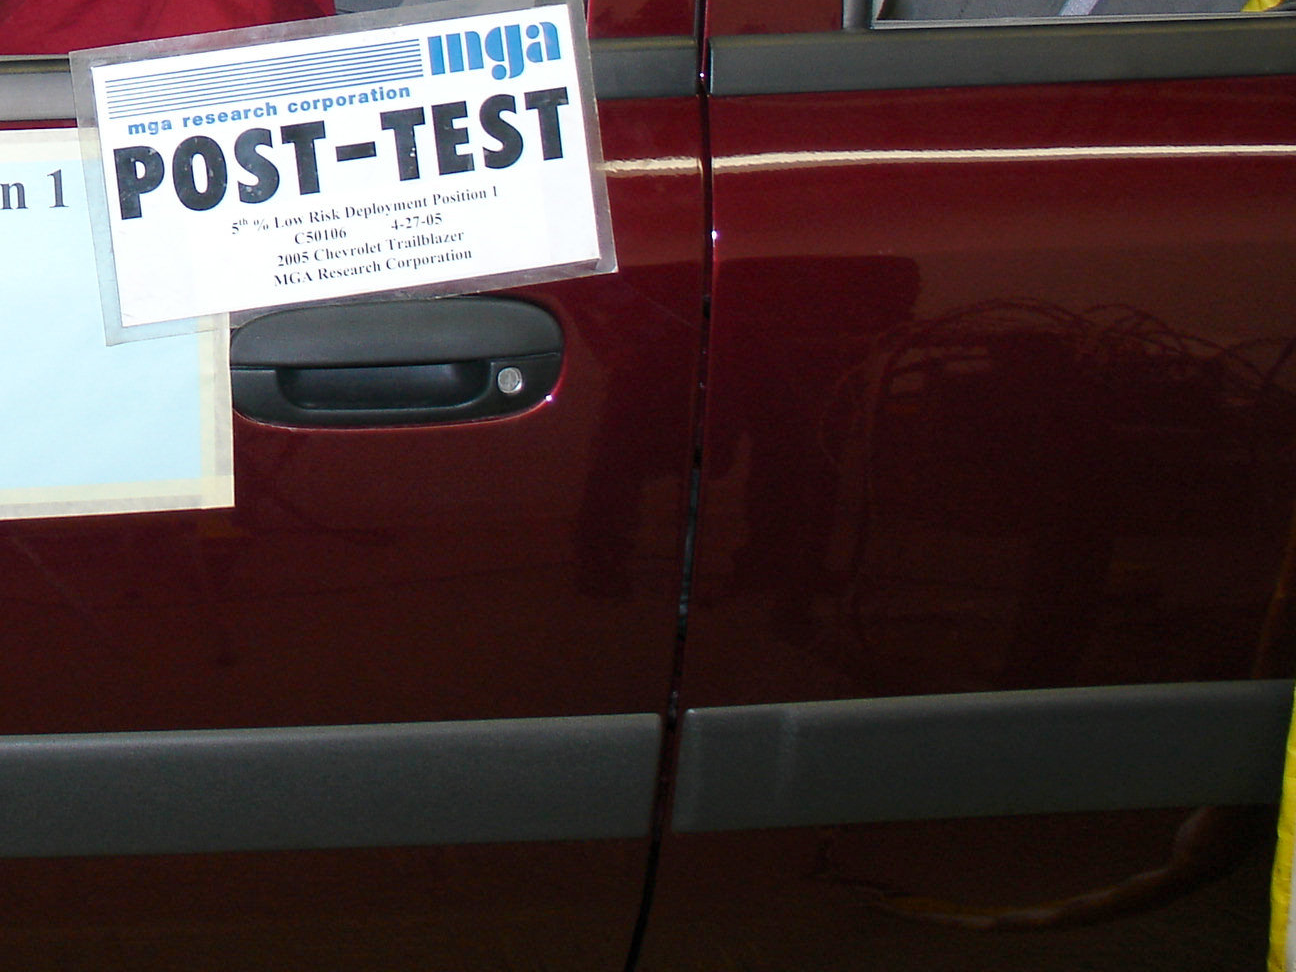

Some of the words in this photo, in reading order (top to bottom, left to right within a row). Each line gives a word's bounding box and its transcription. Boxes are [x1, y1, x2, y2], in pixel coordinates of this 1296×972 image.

[428, 21, 562, 80] mga
[128, 118, 172, 136] mga
[183, 102, 279, 127] research
[287, 85, 411, 115] corporation
[113, 87, 570, 221] POST-TEST
[49, 169, 68, 209] 1
[274, 212, 304, 229] Low
[309, 208, 341, 223] Risk
[345, 196, 428, 221] Deployment
[432, 187, 488, 207] Position
[277, 251, 310, 267] 2005
[313, 241, 382, 263] Chevrolet
[385, 230, 464, 251] Trailblazer
[294, 227, 347, 245] C50106
[391, 212, 443, 231] 4-27-05
[274, 270, 314, 287] MGA
[318, 261, 382, 281] Research
[386, 248, 473, 271] Corporation
